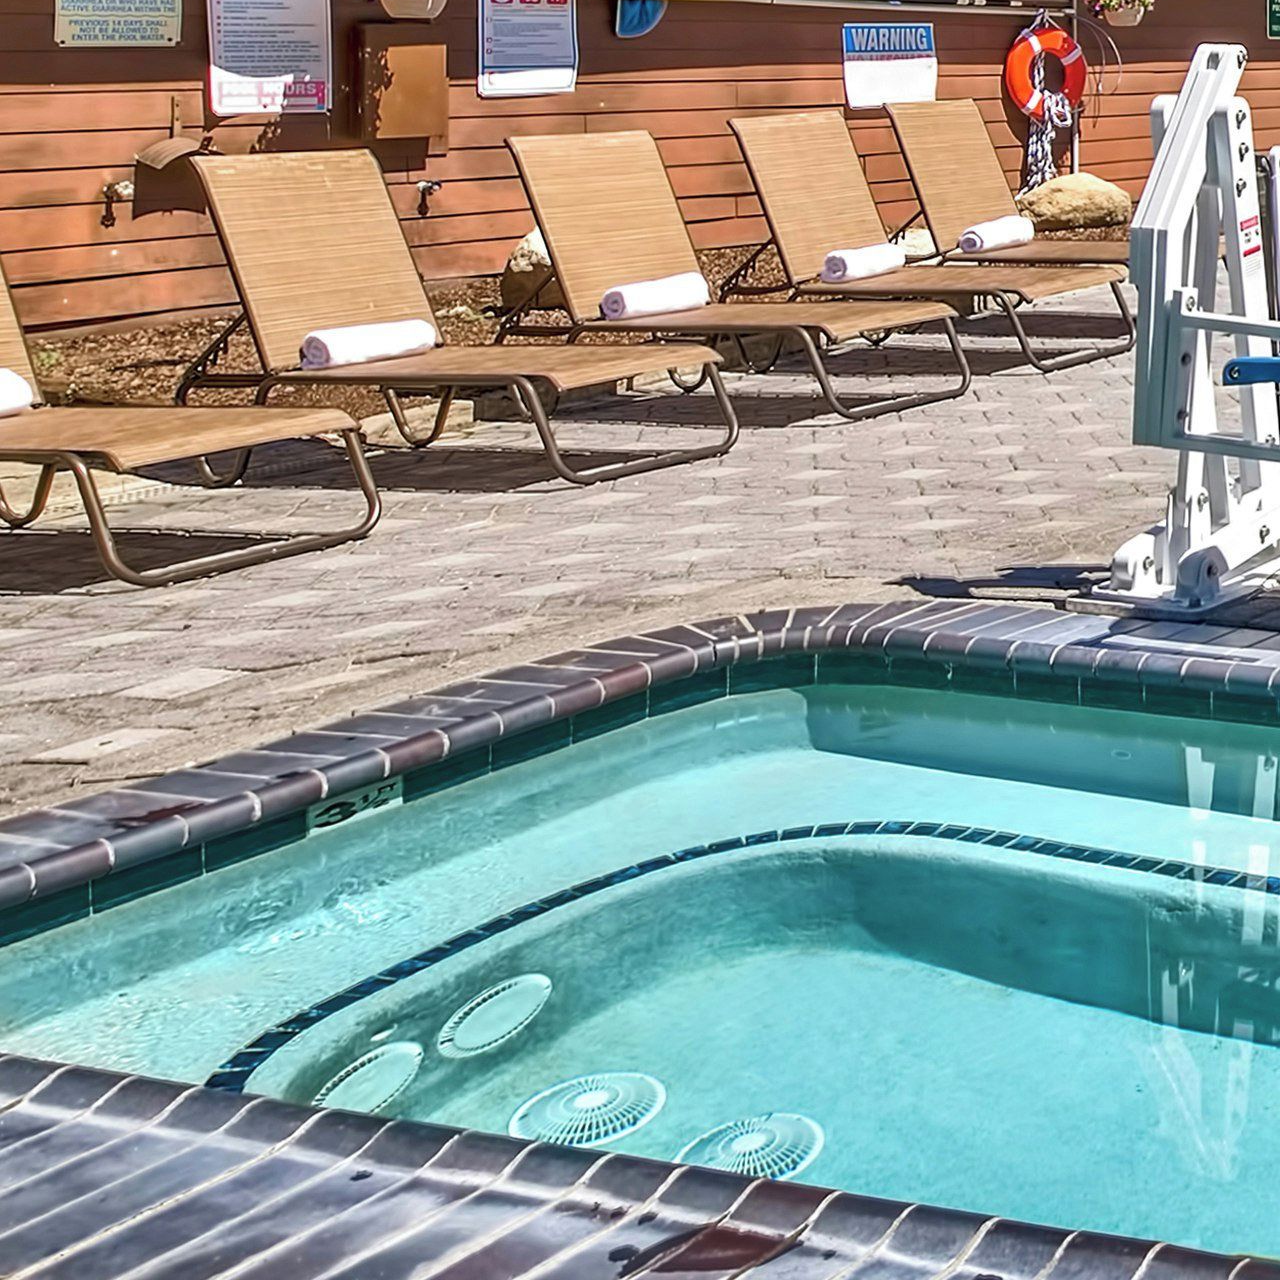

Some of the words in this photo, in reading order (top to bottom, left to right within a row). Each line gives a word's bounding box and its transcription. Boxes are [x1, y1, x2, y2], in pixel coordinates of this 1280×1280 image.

[92, 5, 132, 13] DIARRHEA
[134, 5, 161, 13] WITHIN
[851, 28, 927, 50] WARNING
